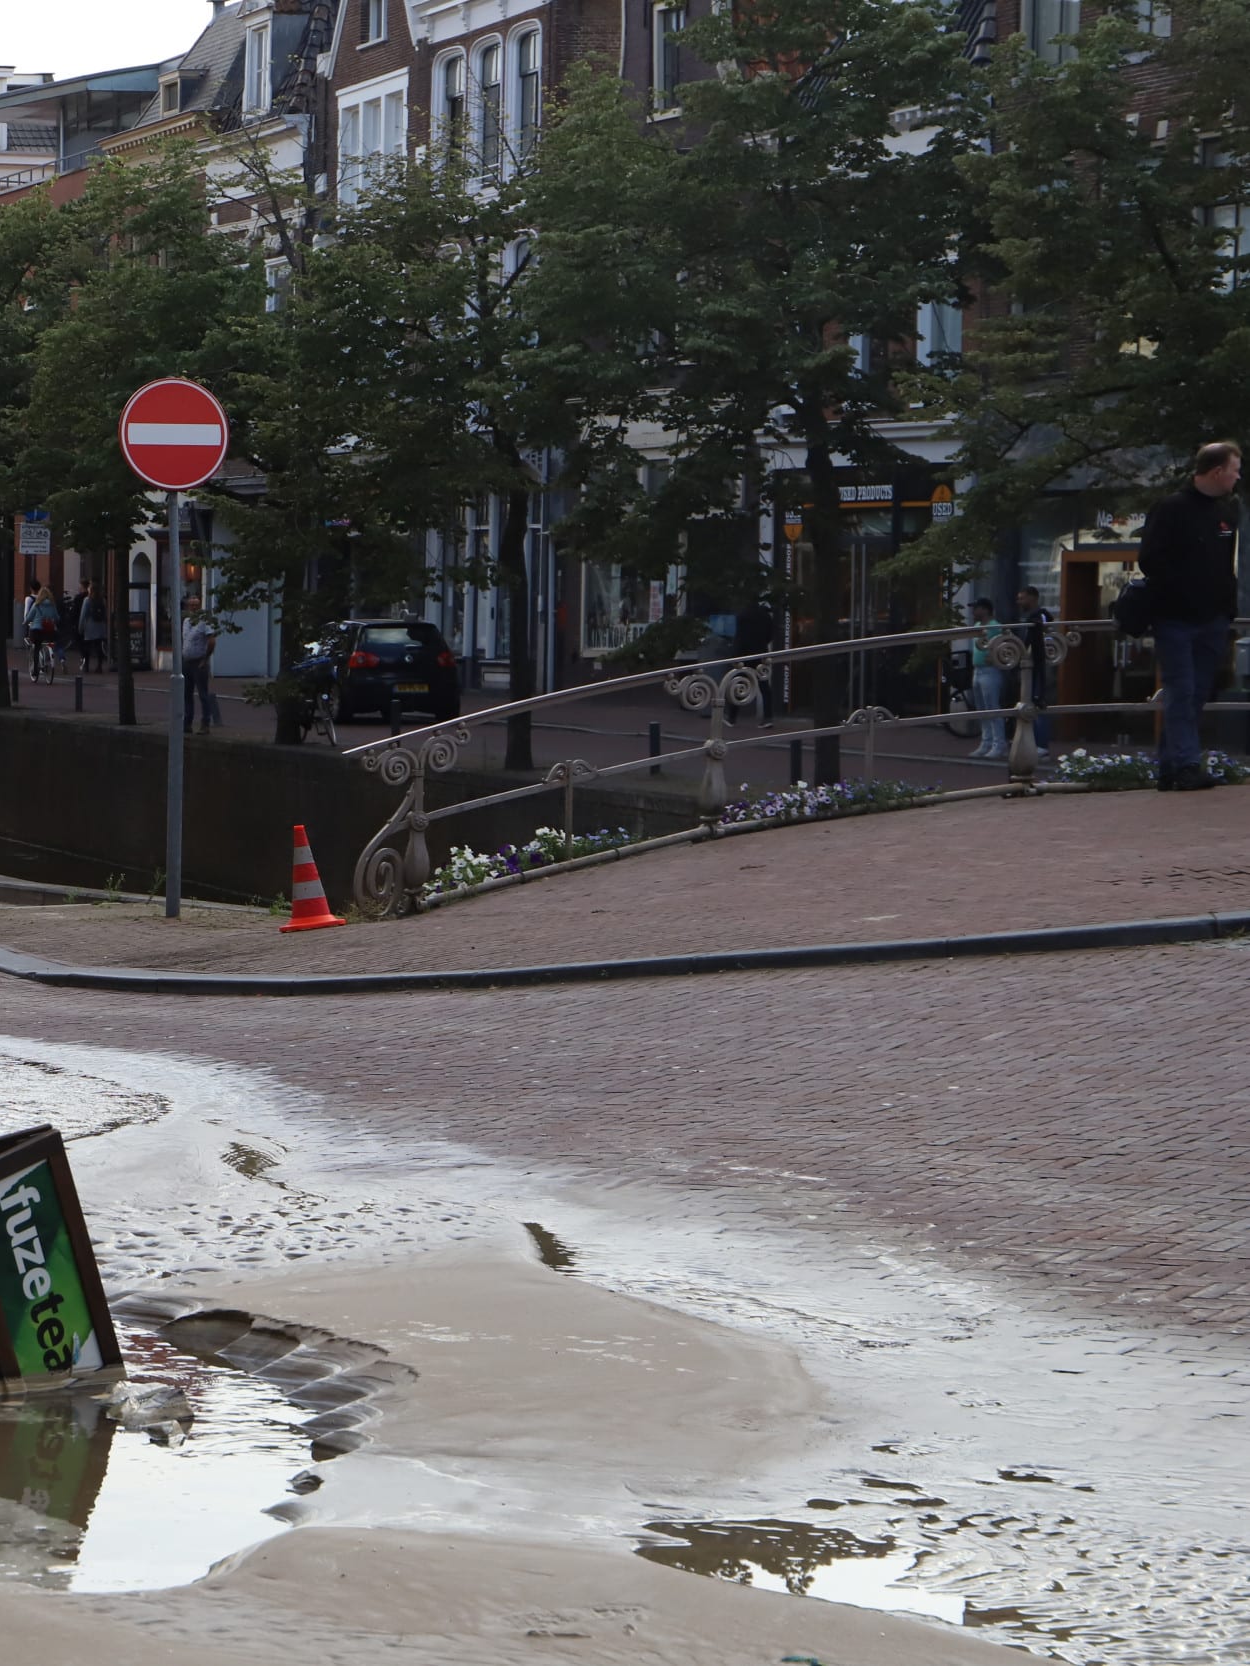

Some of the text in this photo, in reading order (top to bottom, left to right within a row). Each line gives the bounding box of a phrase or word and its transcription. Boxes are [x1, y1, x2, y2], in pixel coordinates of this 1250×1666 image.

[857, 484, 894, 501] PRODUCTS
[932, 502, 952, 516] USED
[0, 1184, 73, 1374] fuzetea
